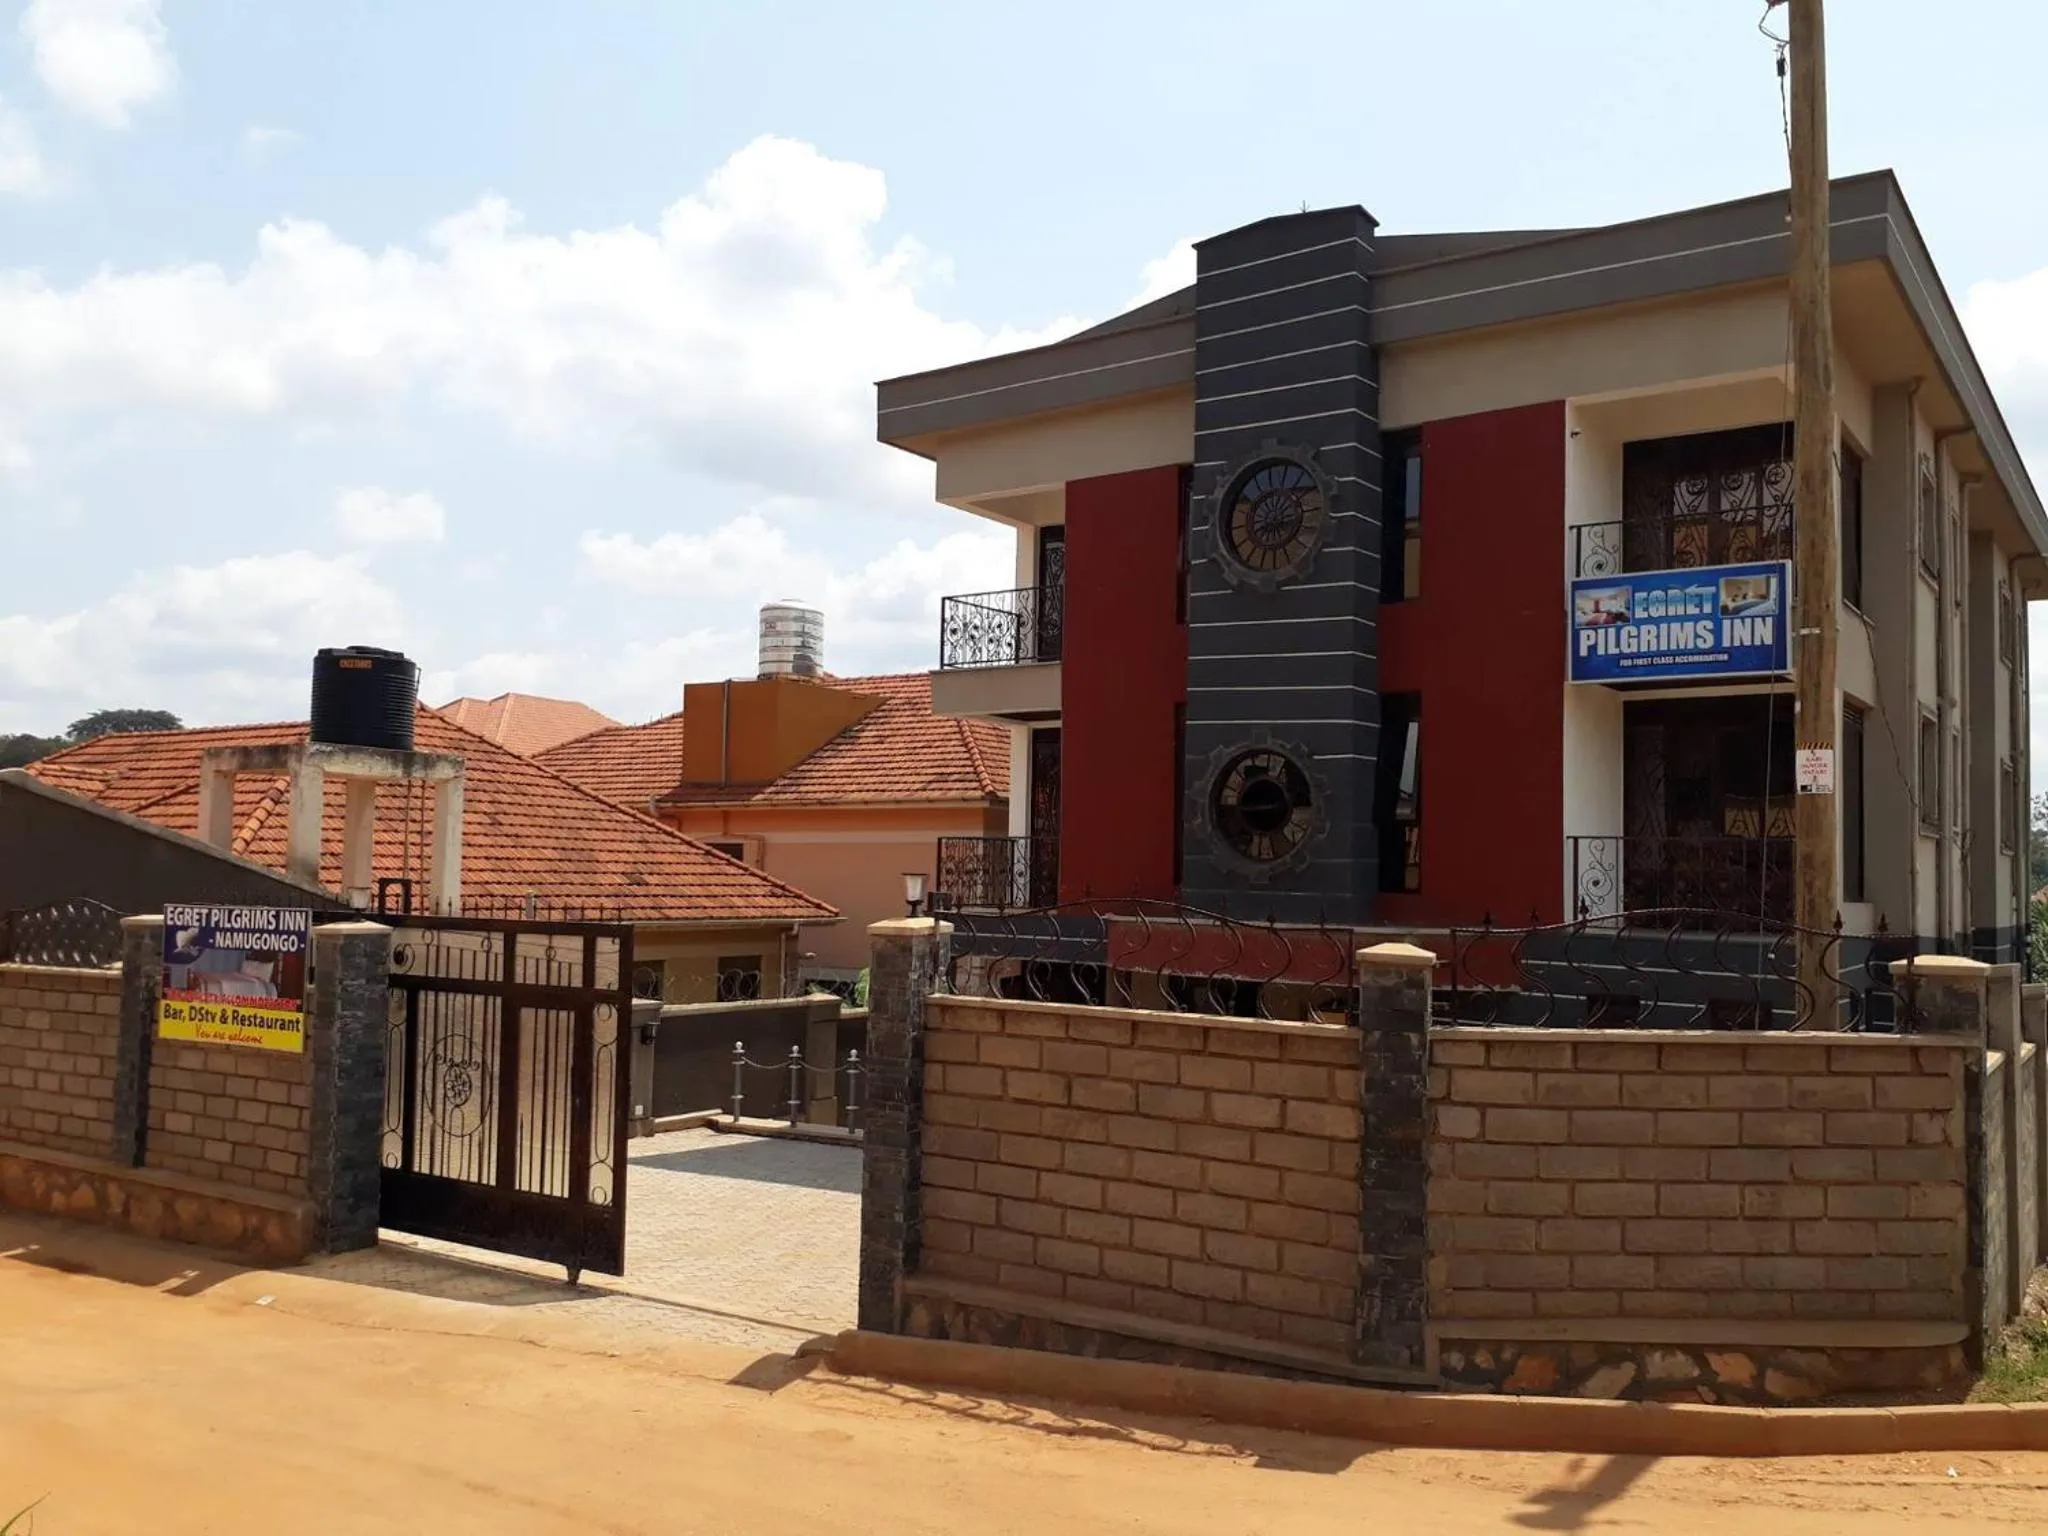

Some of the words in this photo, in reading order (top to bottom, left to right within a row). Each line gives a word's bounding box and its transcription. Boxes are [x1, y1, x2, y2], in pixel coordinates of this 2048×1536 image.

[1634, 585, 1716, 618] EGRET
[1579, 620, 1714, 657] PILGRIMS
[1722, 616, 1773, 647] INN
[1633, 656, 1652, 666] FIRST
[1652, 655, 1674, 665] CLASS
[166, 906, 209, 927] EGRET
[210, 908, 276, 930] PILGRIMS
[279, 910, 307, 931] INN
[215, 931, 299, 952] NAMUGONGO
[163, 1003, 187, 1022] Bar,
[189, 1005, 217, 1023] DStv
[219, 1009, 229, 1025] &
[231, 1009, 301, 1032] Restaurant
[196, 1024, 211, 1038] You
[212, 1031, 226, 1040] are
